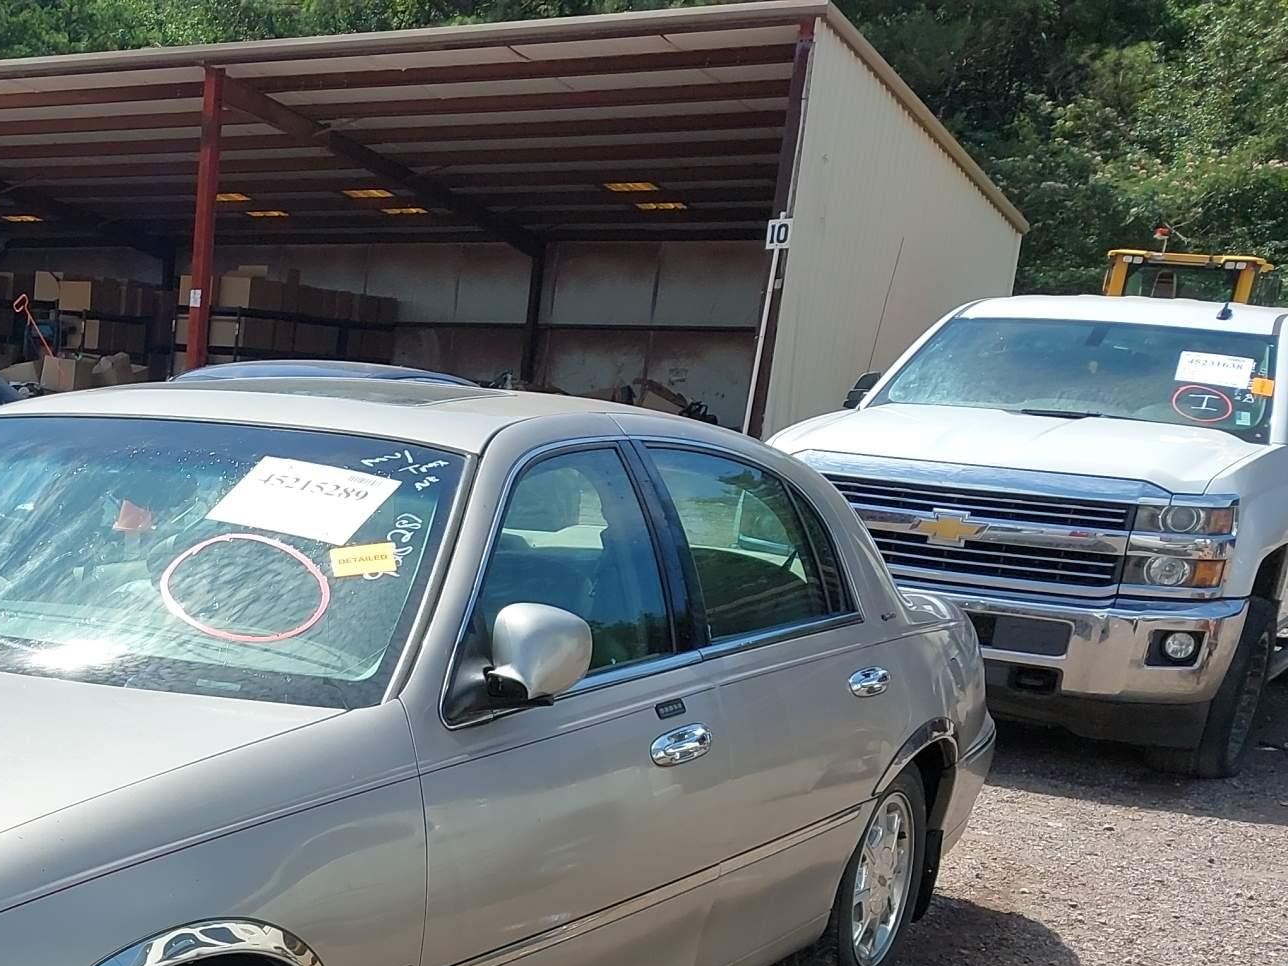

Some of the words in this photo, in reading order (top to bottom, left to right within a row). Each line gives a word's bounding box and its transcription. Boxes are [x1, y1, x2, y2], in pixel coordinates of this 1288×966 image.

[769, 223, 790, 244] 10
[259, 473, 369, 501] 45215289
[338, 553, 388, 565] DETAILED
